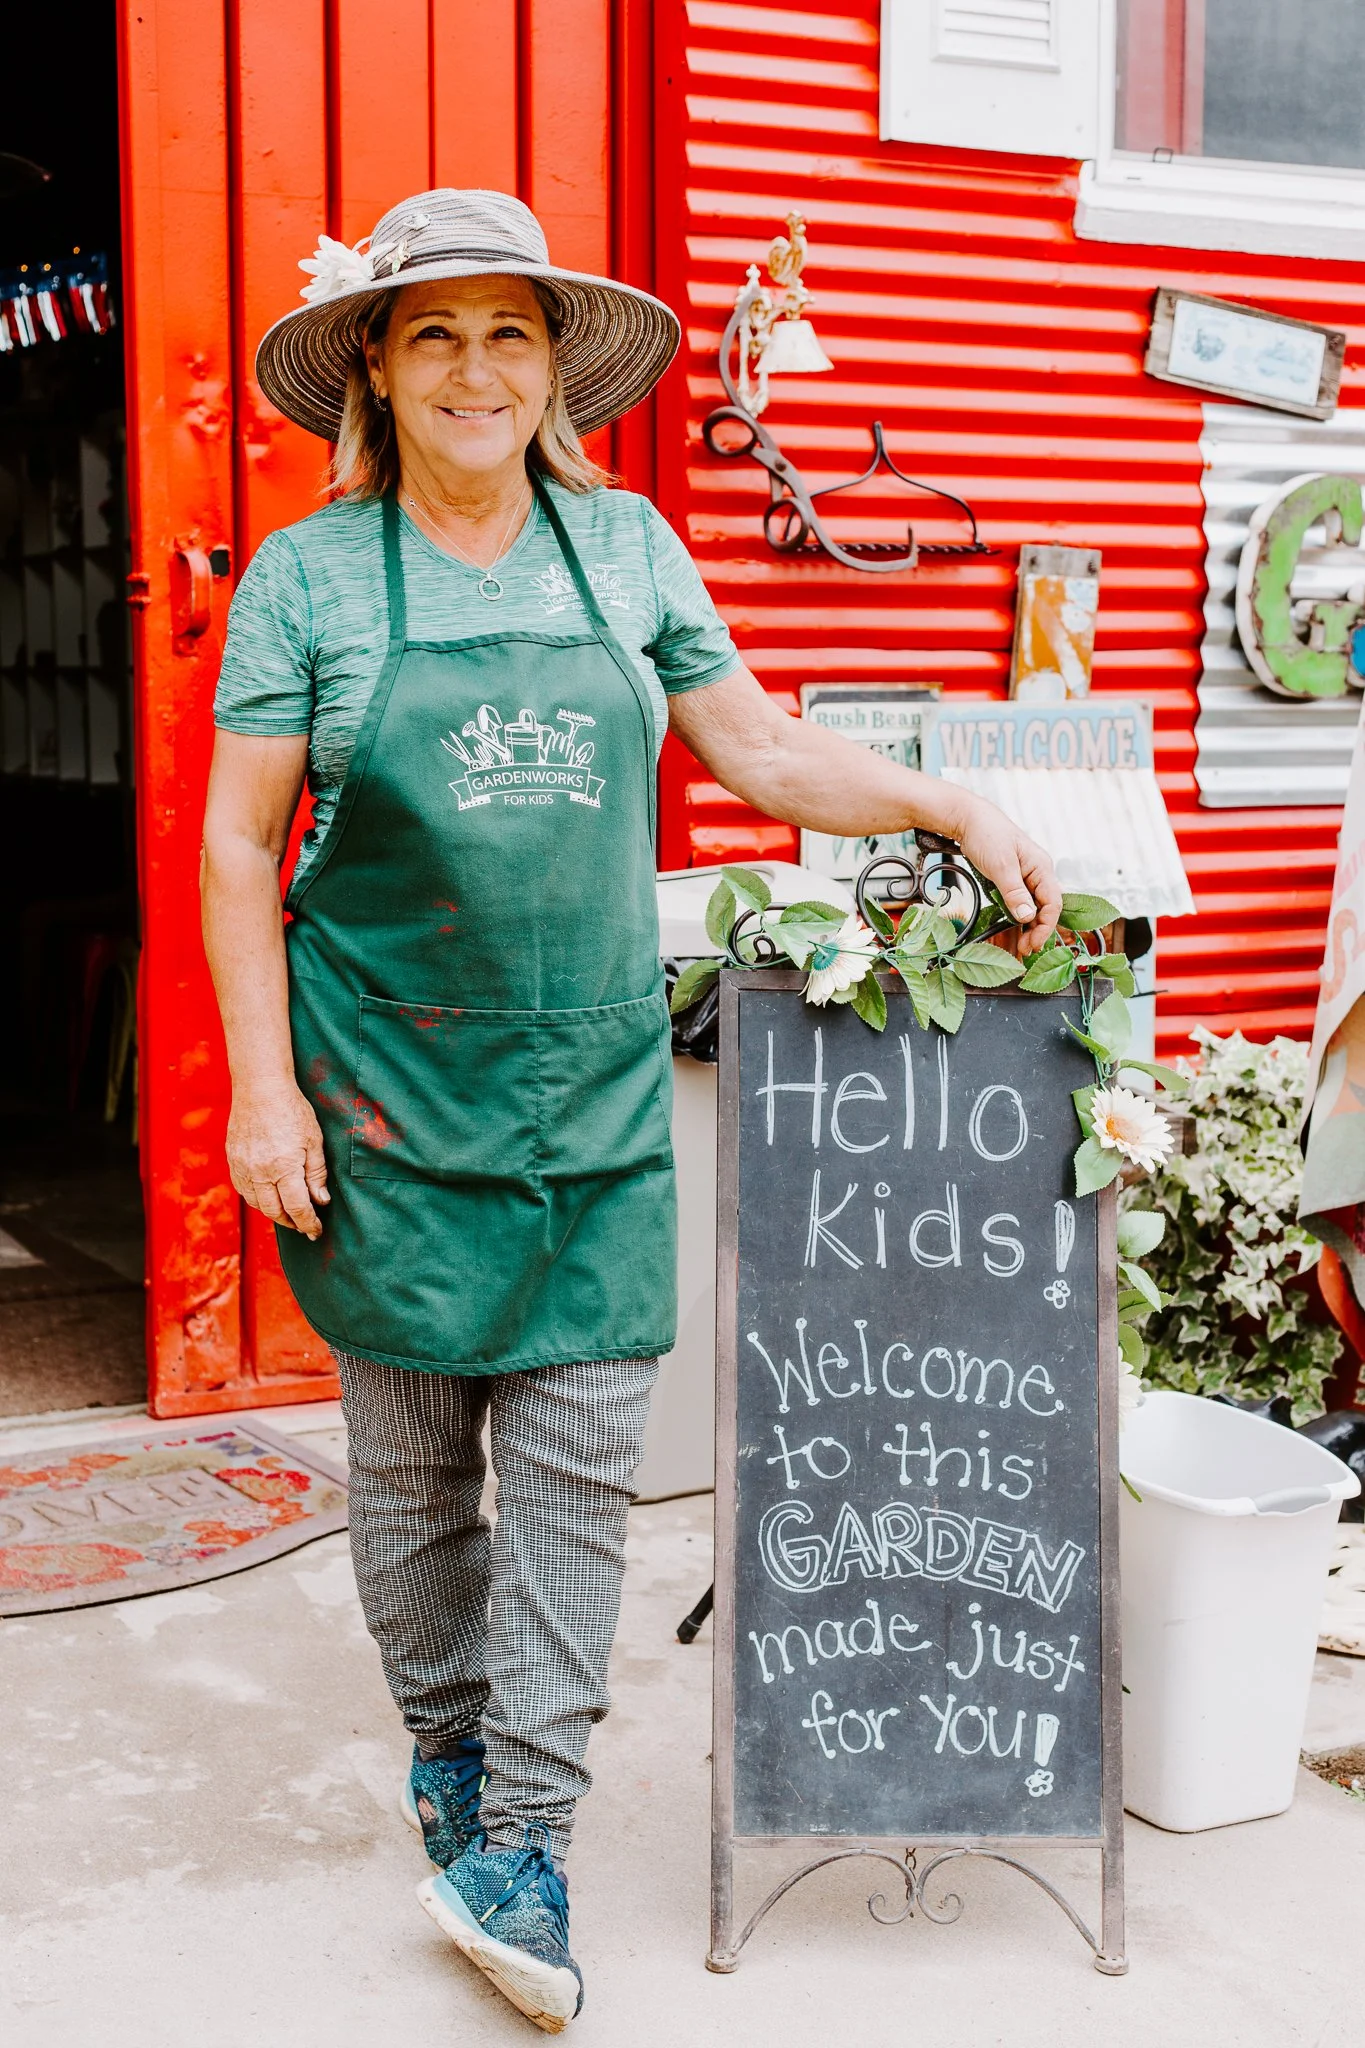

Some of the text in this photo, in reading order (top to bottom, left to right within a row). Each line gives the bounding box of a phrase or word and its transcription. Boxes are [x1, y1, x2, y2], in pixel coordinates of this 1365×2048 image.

[552, 591, 618, 605] GARDEORKS
[938, 717, 1139, 768] WELCOME
[472, 770, 584, 791] GARDENWORKS
[504, 794, 554, 806] FOR KIDS
[756, 1026, 1028, 1161] Hello
[747, 1318, 1065, 1416] Welcome
[767, 1421, 1034, 1500] to this
[758, 1500, 1086, 1613] GARDEN
[748, 1599, 1086, 1692] made just
[802, 1690, 899, 1759] for
